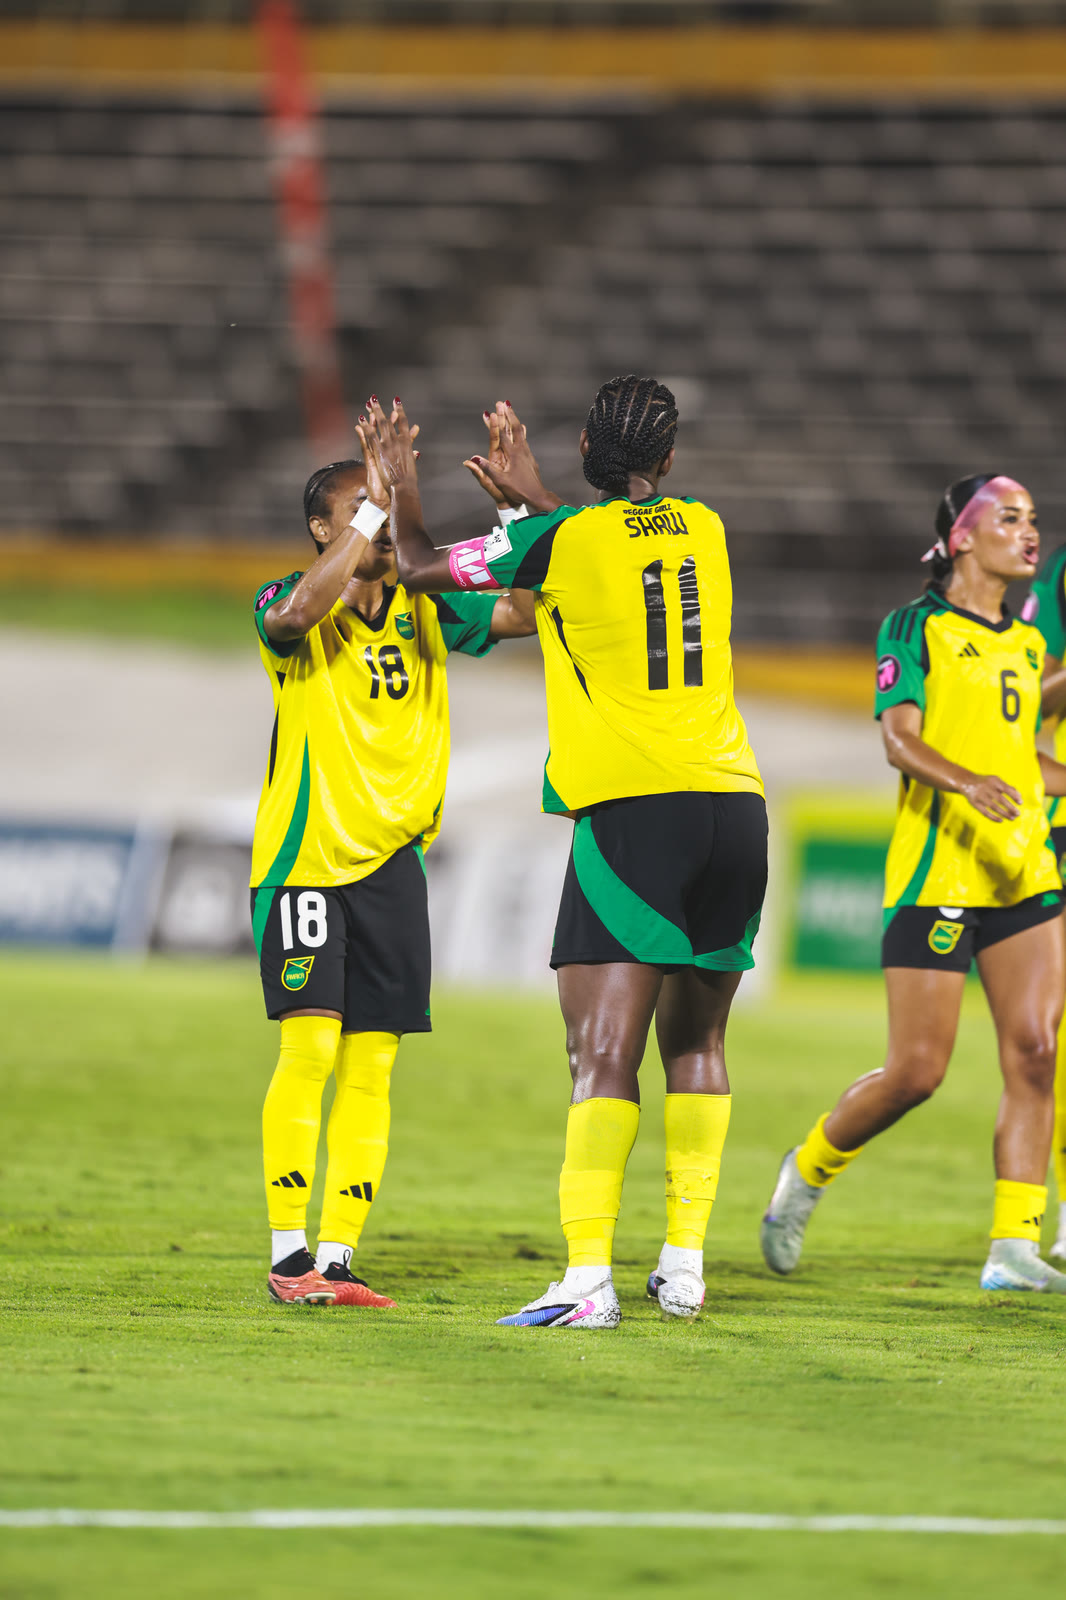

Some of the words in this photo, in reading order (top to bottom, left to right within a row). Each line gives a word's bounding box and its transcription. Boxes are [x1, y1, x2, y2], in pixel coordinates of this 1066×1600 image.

[623, 507, 654, 516] REGGAE
[654, 503, 672, 514] GIRLZ
[624, 511, 690, 538] SHAW
[642, 555, 703, 691] 11
[364, 644, 409, 700] 18
[1000, 669, 1021, 722] 6
[280, 891, 327, 951] 18
